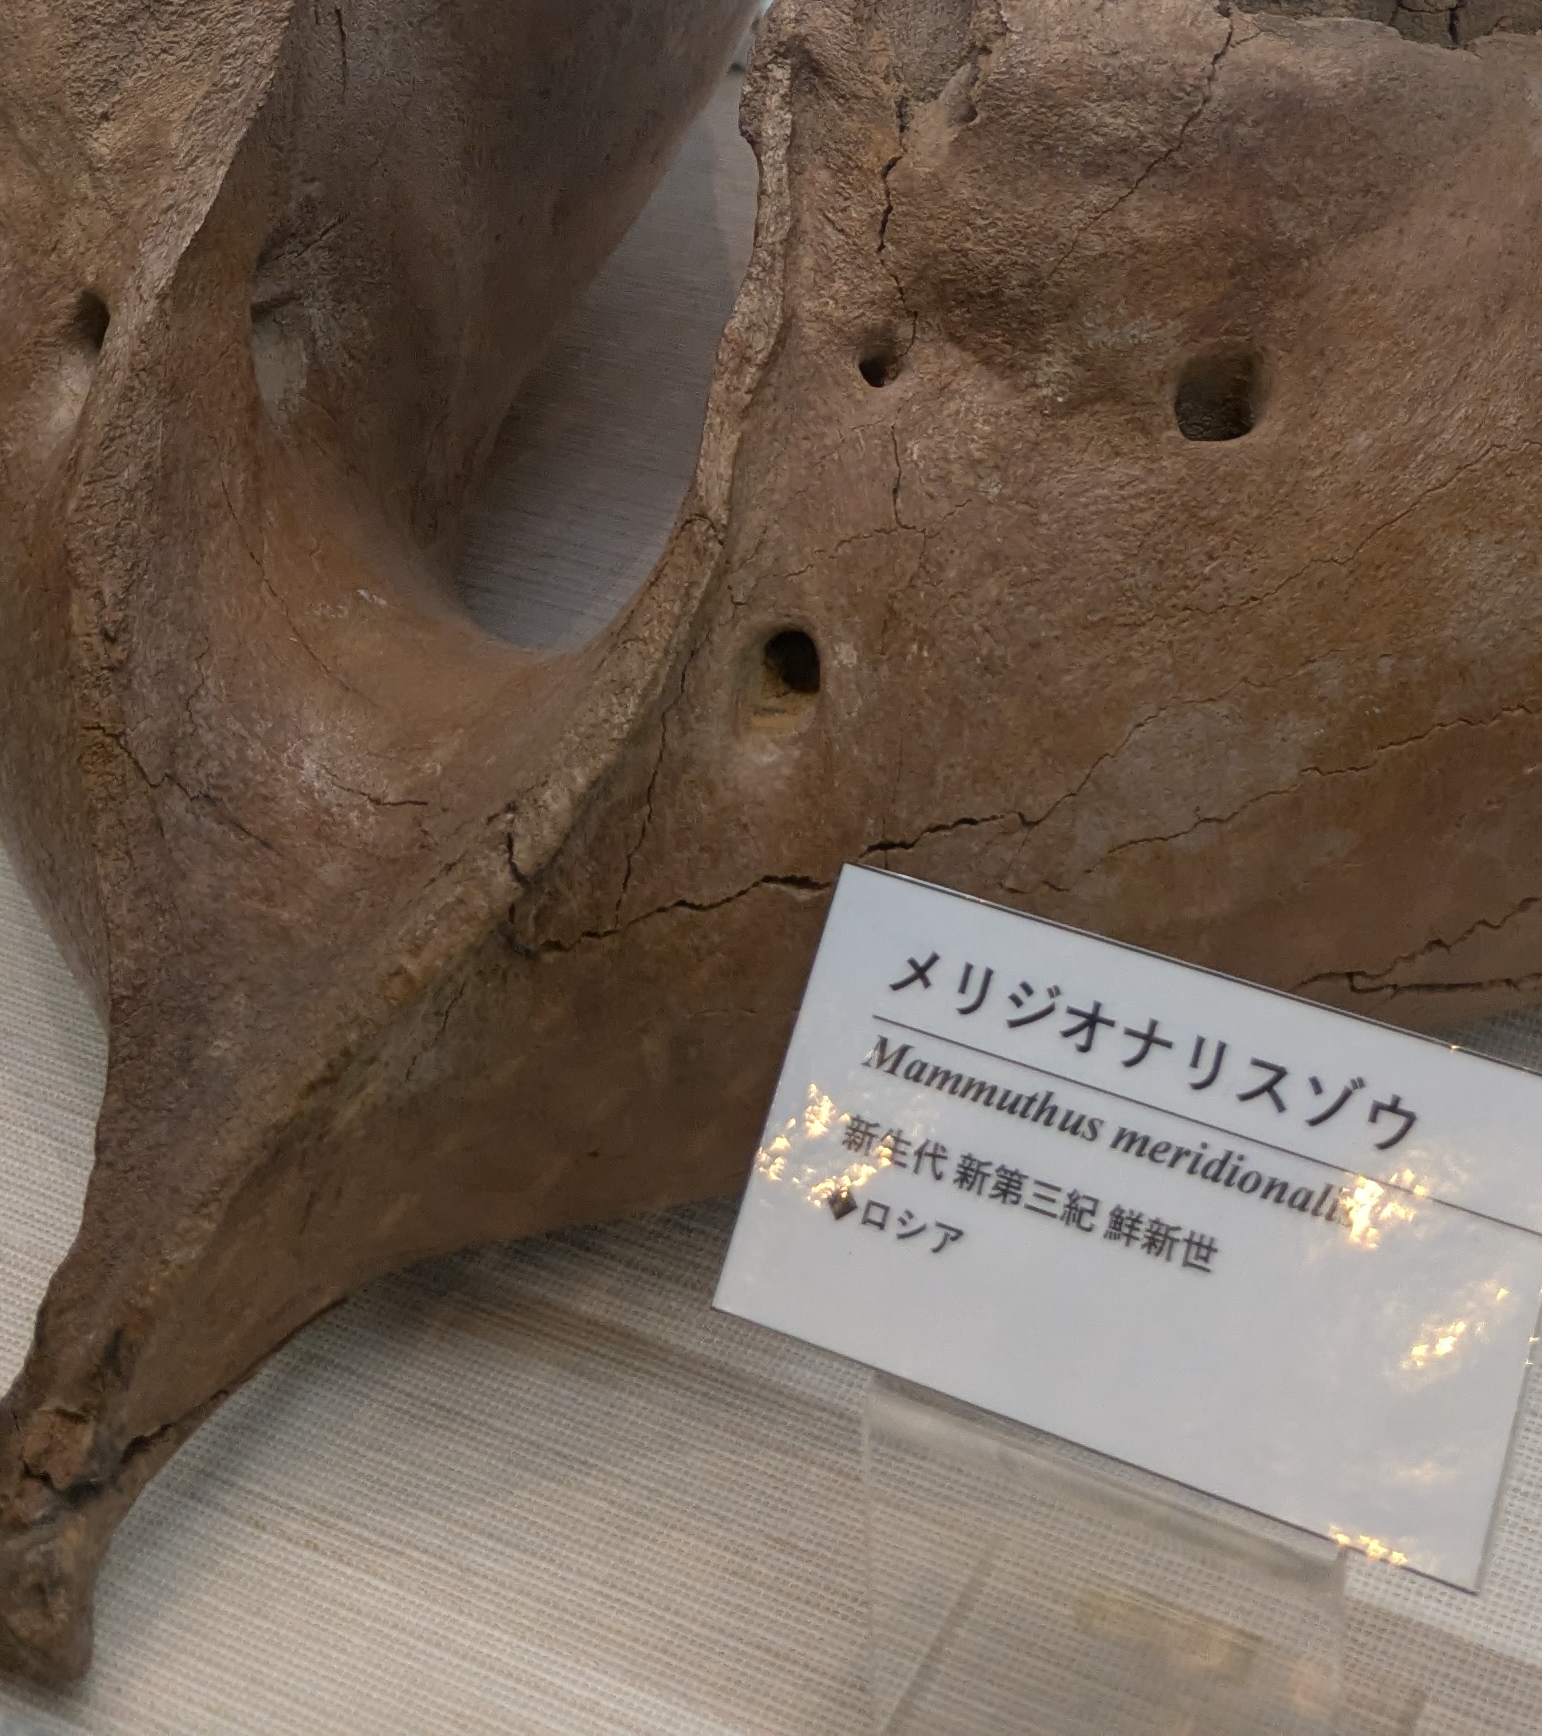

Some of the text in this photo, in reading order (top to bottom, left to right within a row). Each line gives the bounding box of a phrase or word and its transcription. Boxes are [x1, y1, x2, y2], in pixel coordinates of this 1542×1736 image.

[861, 1034, 1105, 1142] Mammuthus
[889, 951, 1417, 1150] メリジオナリスゾウ
[842, 1114, 1218, 1273] 新生代 新第三紀 鮮新世
[861, 1199, 964, 1253] ロシア
